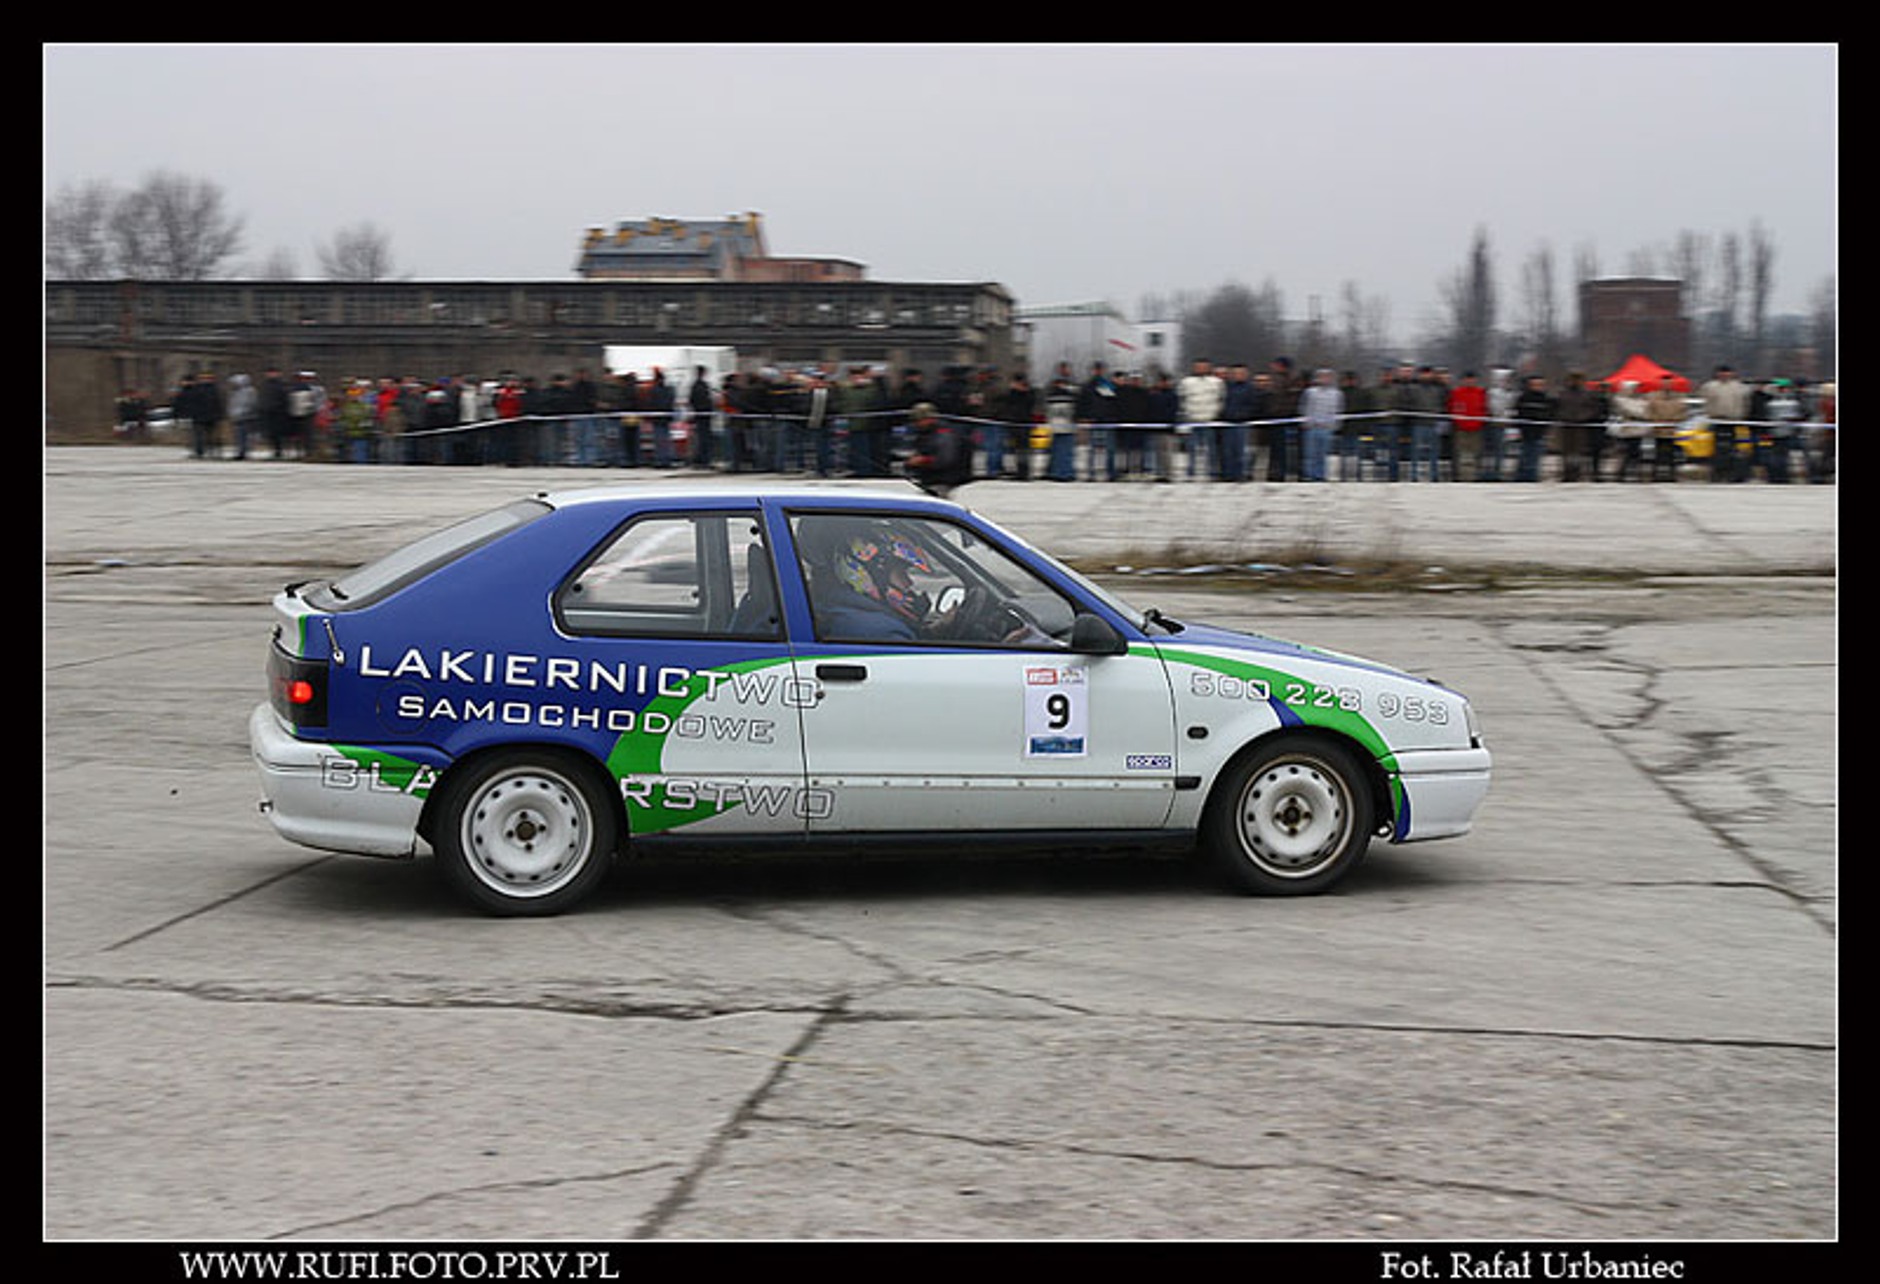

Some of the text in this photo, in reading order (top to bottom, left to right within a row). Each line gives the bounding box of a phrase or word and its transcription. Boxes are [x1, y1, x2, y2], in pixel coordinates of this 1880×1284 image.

[359, 645, 822, 709] LAKIERNICTWO
[1190, 672, 1449, 726] 500 228 953
[396, 695, 775, 744] SAMOCHODOWE
[1046, 694, 1070, 730] 9
